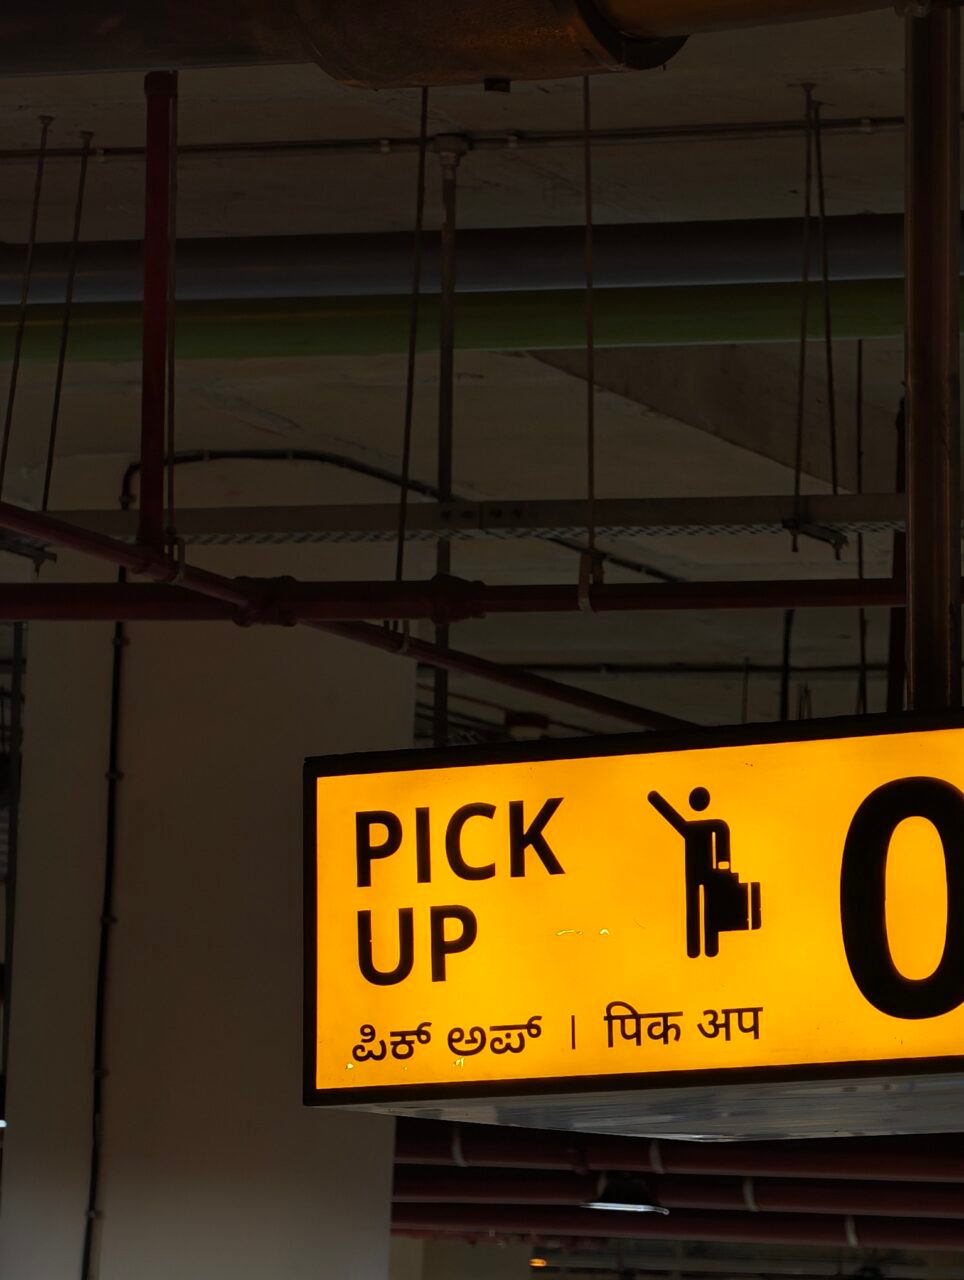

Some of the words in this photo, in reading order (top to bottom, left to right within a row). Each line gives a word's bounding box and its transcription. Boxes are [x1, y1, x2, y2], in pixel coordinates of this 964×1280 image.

[355, 797, 565, 888] PICK
[357, 904, 478, 986] UP
[352, 1022, 432, 1062] ಪಿಕ್
[447, 1015, 543, 1057] ಅಪ್
[603, 1001, 683, 1048] पिक
[697, 1005, 763, 1042] अप
